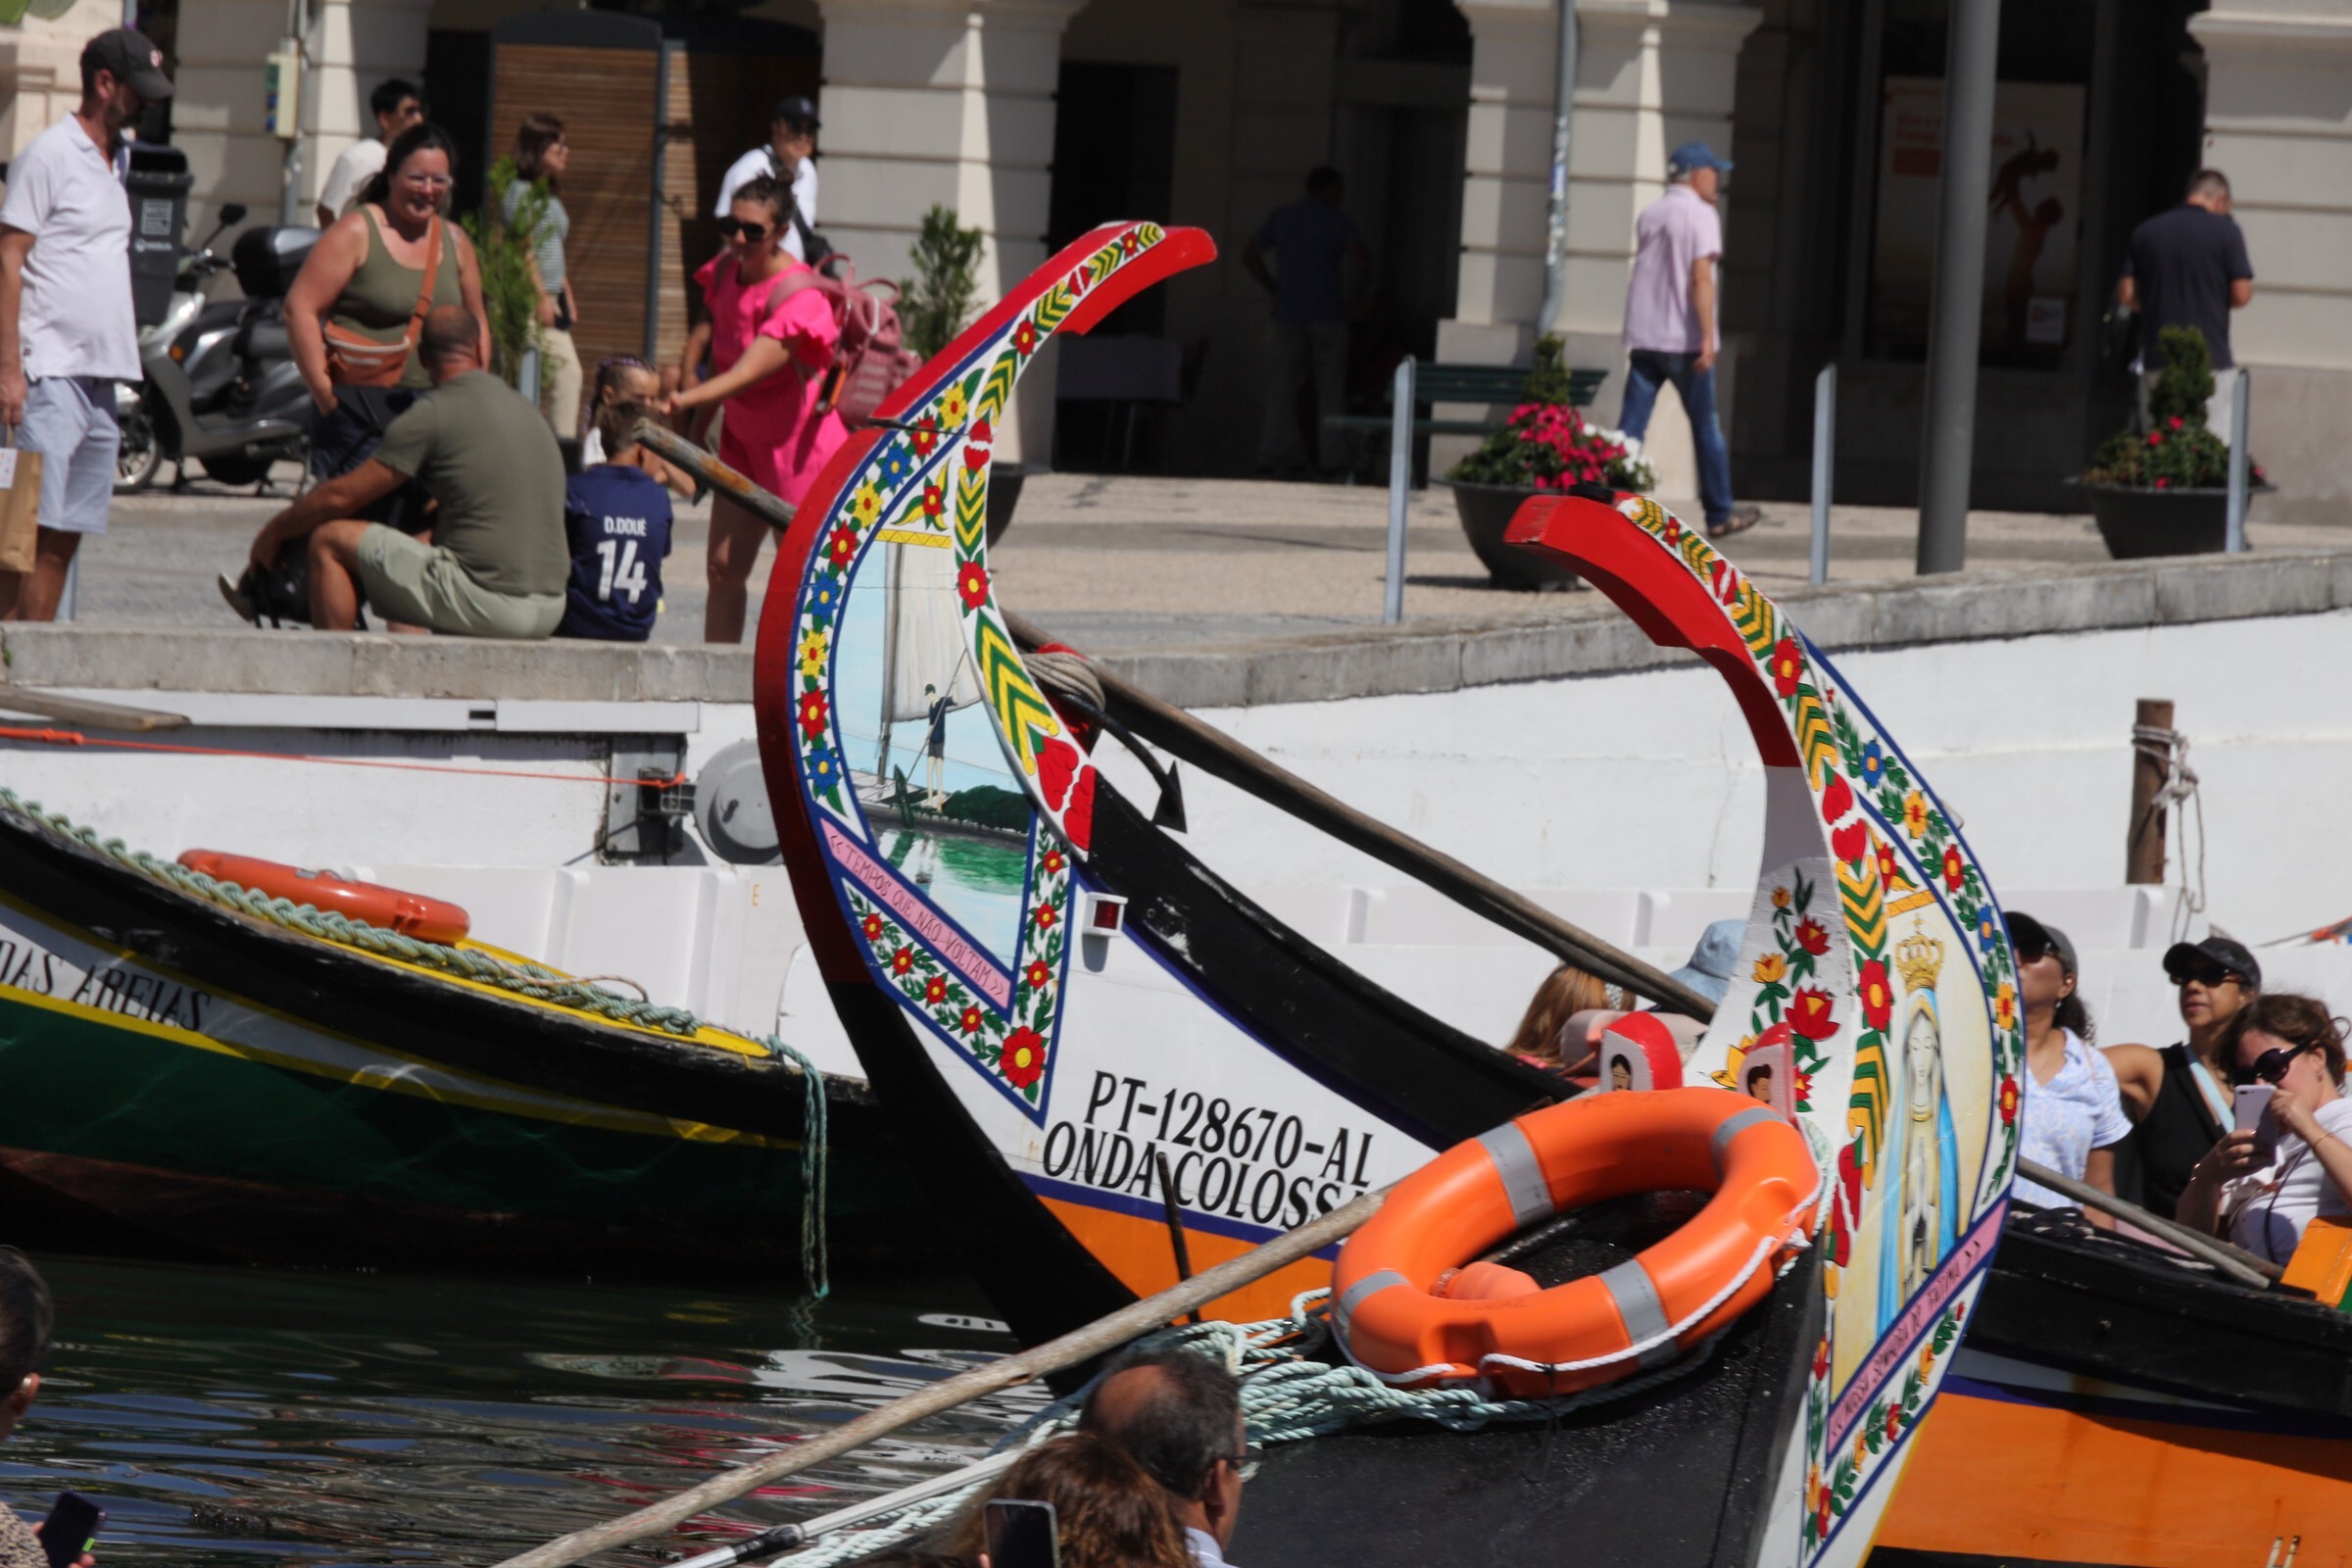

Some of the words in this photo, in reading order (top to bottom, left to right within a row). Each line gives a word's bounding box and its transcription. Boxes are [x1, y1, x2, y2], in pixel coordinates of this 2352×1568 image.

[597, 539, 648, 604] 14
[892, 890, 916, 918] QUE
[914, 909, 943, 942] NÃO
[70, 963, 211, 1032] AREIAS
[1083, 1069, 1374, 1189] PT-128670-AL
[1043, 1120, 1157, 1199] ONDA
[1173, 1150, 1365, 1232] COLOSS
